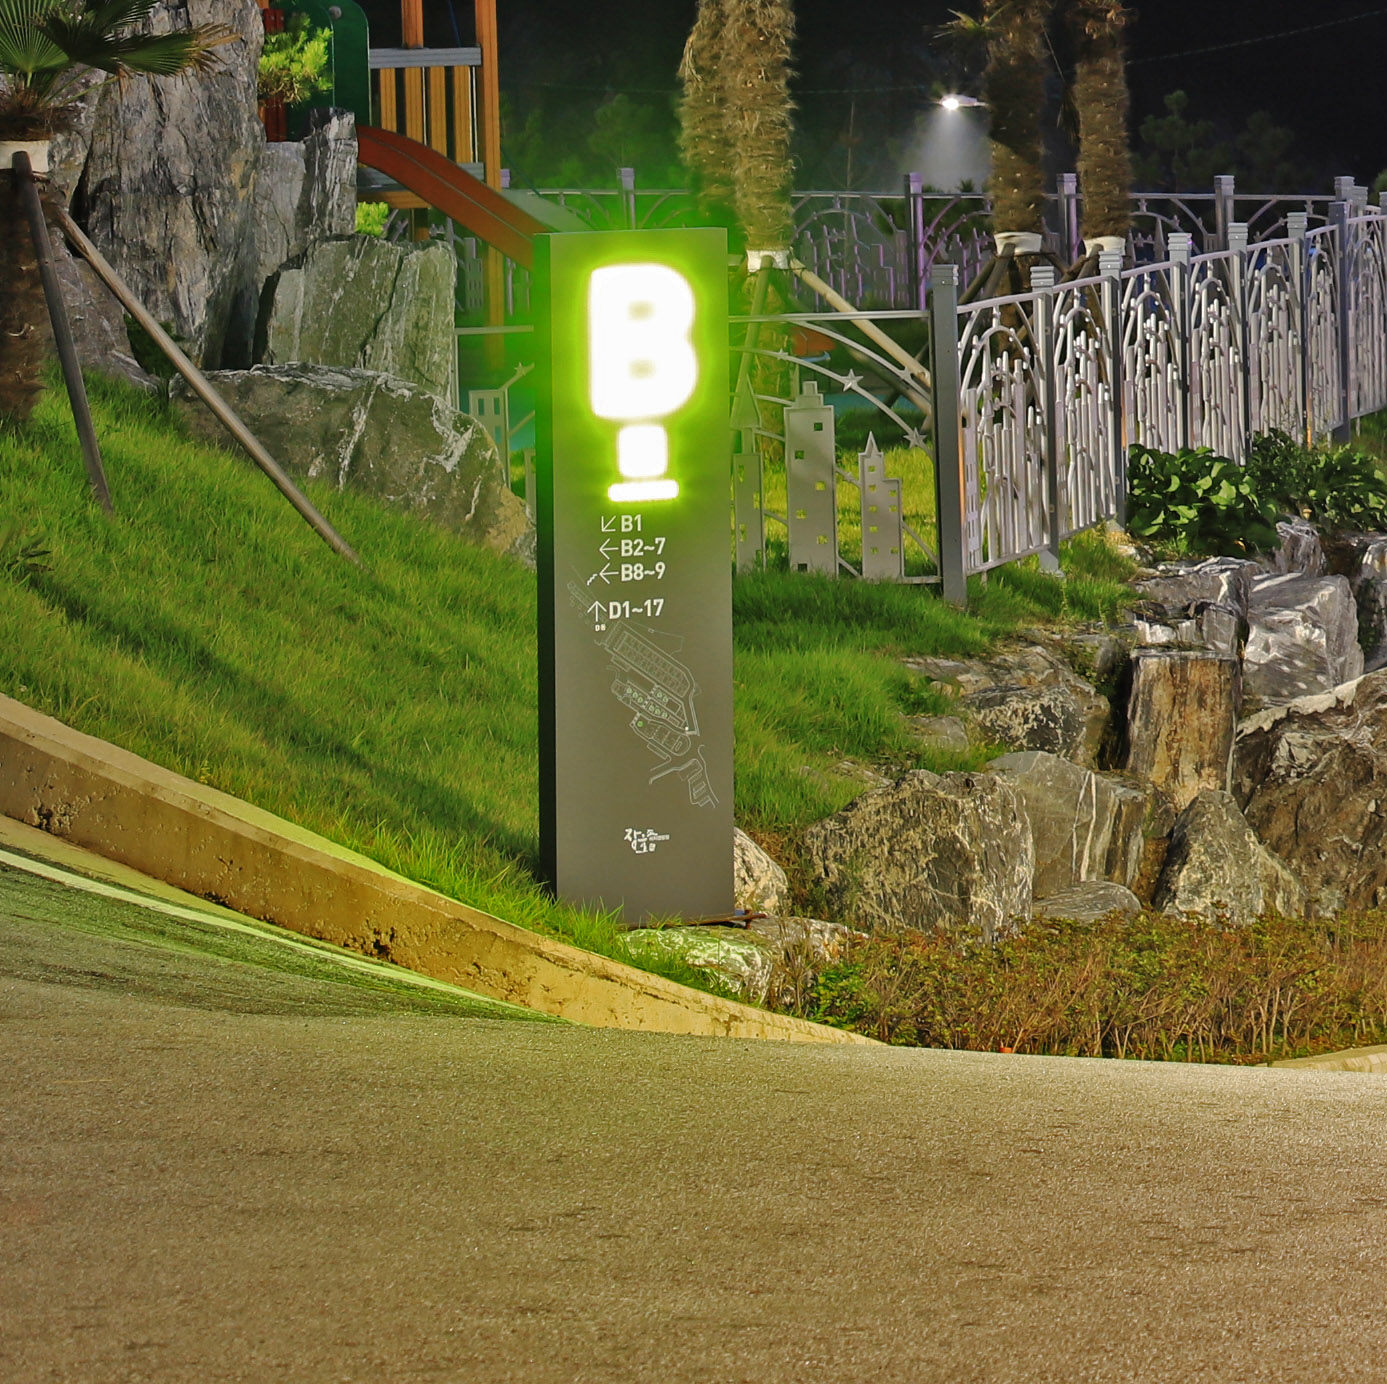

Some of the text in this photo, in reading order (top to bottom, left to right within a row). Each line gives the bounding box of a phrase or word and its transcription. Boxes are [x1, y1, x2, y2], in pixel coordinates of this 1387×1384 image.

[588, 262, 698, 420] B
[621, 514, 642, 532] B1
[621, 537, 666, 557] B2~7
[621, 561, 666, 582] B8~9
[609, 598, 665, 620] D1~17
